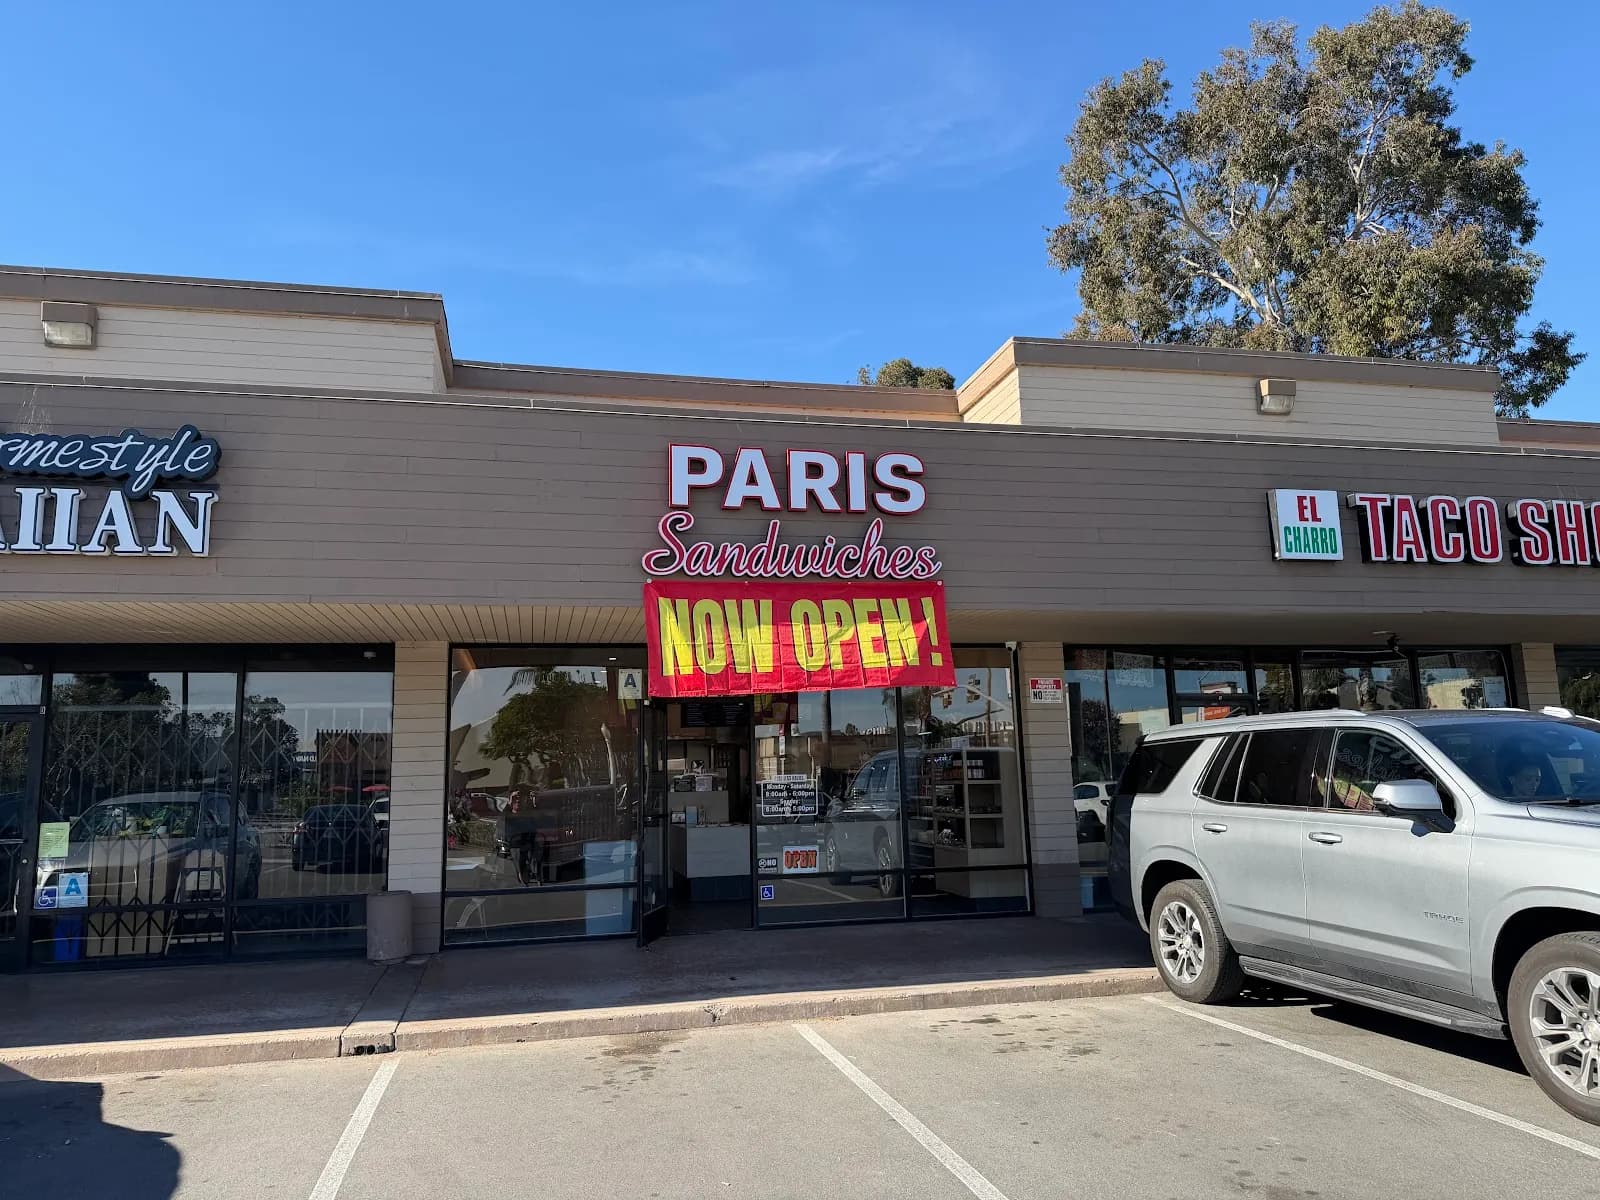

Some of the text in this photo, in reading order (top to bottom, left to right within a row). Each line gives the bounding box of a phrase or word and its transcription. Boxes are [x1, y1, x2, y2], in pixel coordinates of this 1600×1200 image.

[0, 431, 212, 492] mestyle
[668, 442, 927, 514] PARIS
[0, 487, 215, 556] IIAN
[1296, 495, 1322, 523] EL
[1354, 493, 1600, 565] TACO SH
[642, 510, 942, 579] Sandwiches
[1283, 525, 1338, 555] CHARRO
[658, 596, 944, 677] NOW OPEN!
[624, 673, 637, 688] A
[1033, 690, 1043, 700] NO
[784, 850, 817, 869] OPEN
[64, 878, 82, 894] A
